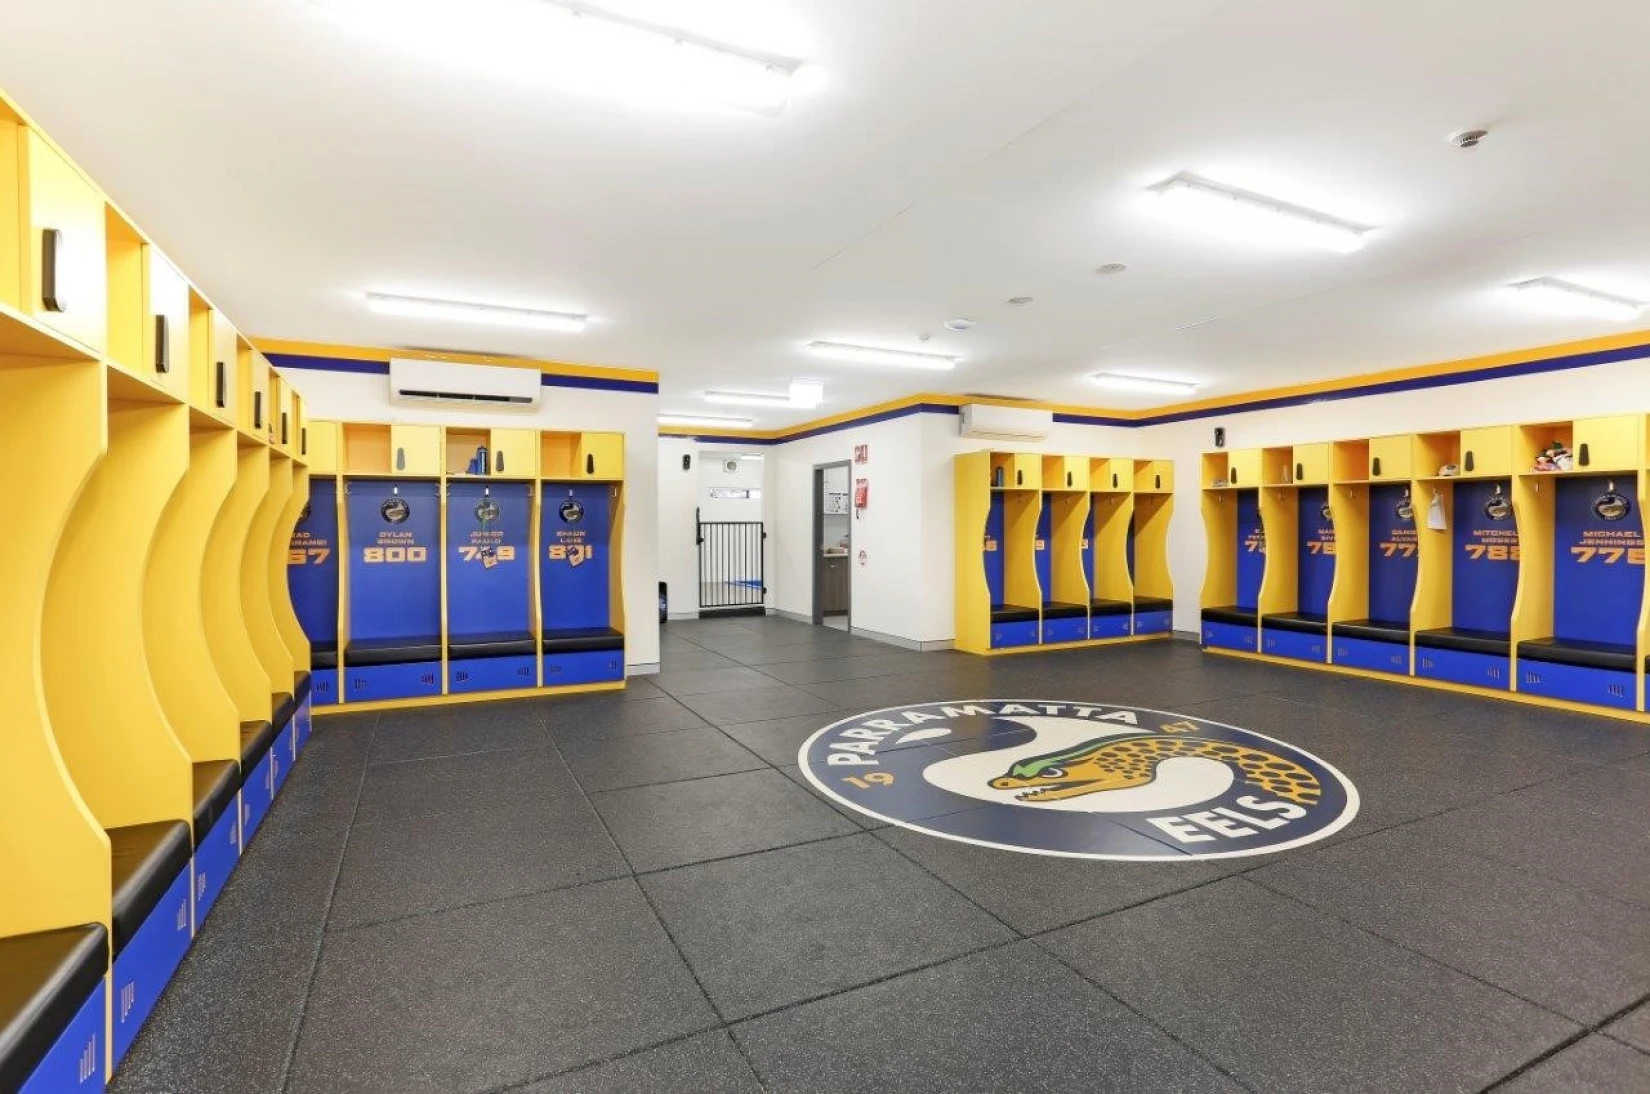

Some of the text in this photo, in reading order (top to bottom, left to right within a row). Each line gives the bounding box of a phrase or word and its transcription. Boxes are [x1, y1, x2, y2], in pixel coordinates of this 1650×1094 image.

[363, 546, 428, 564] 800
[827, 703, 1138, 767] PARRAMATTA
[1160, 720, 1200, 735] 47
[841, 771, 895, 790] 19
[1145, 795, 1307, 843] EELS
